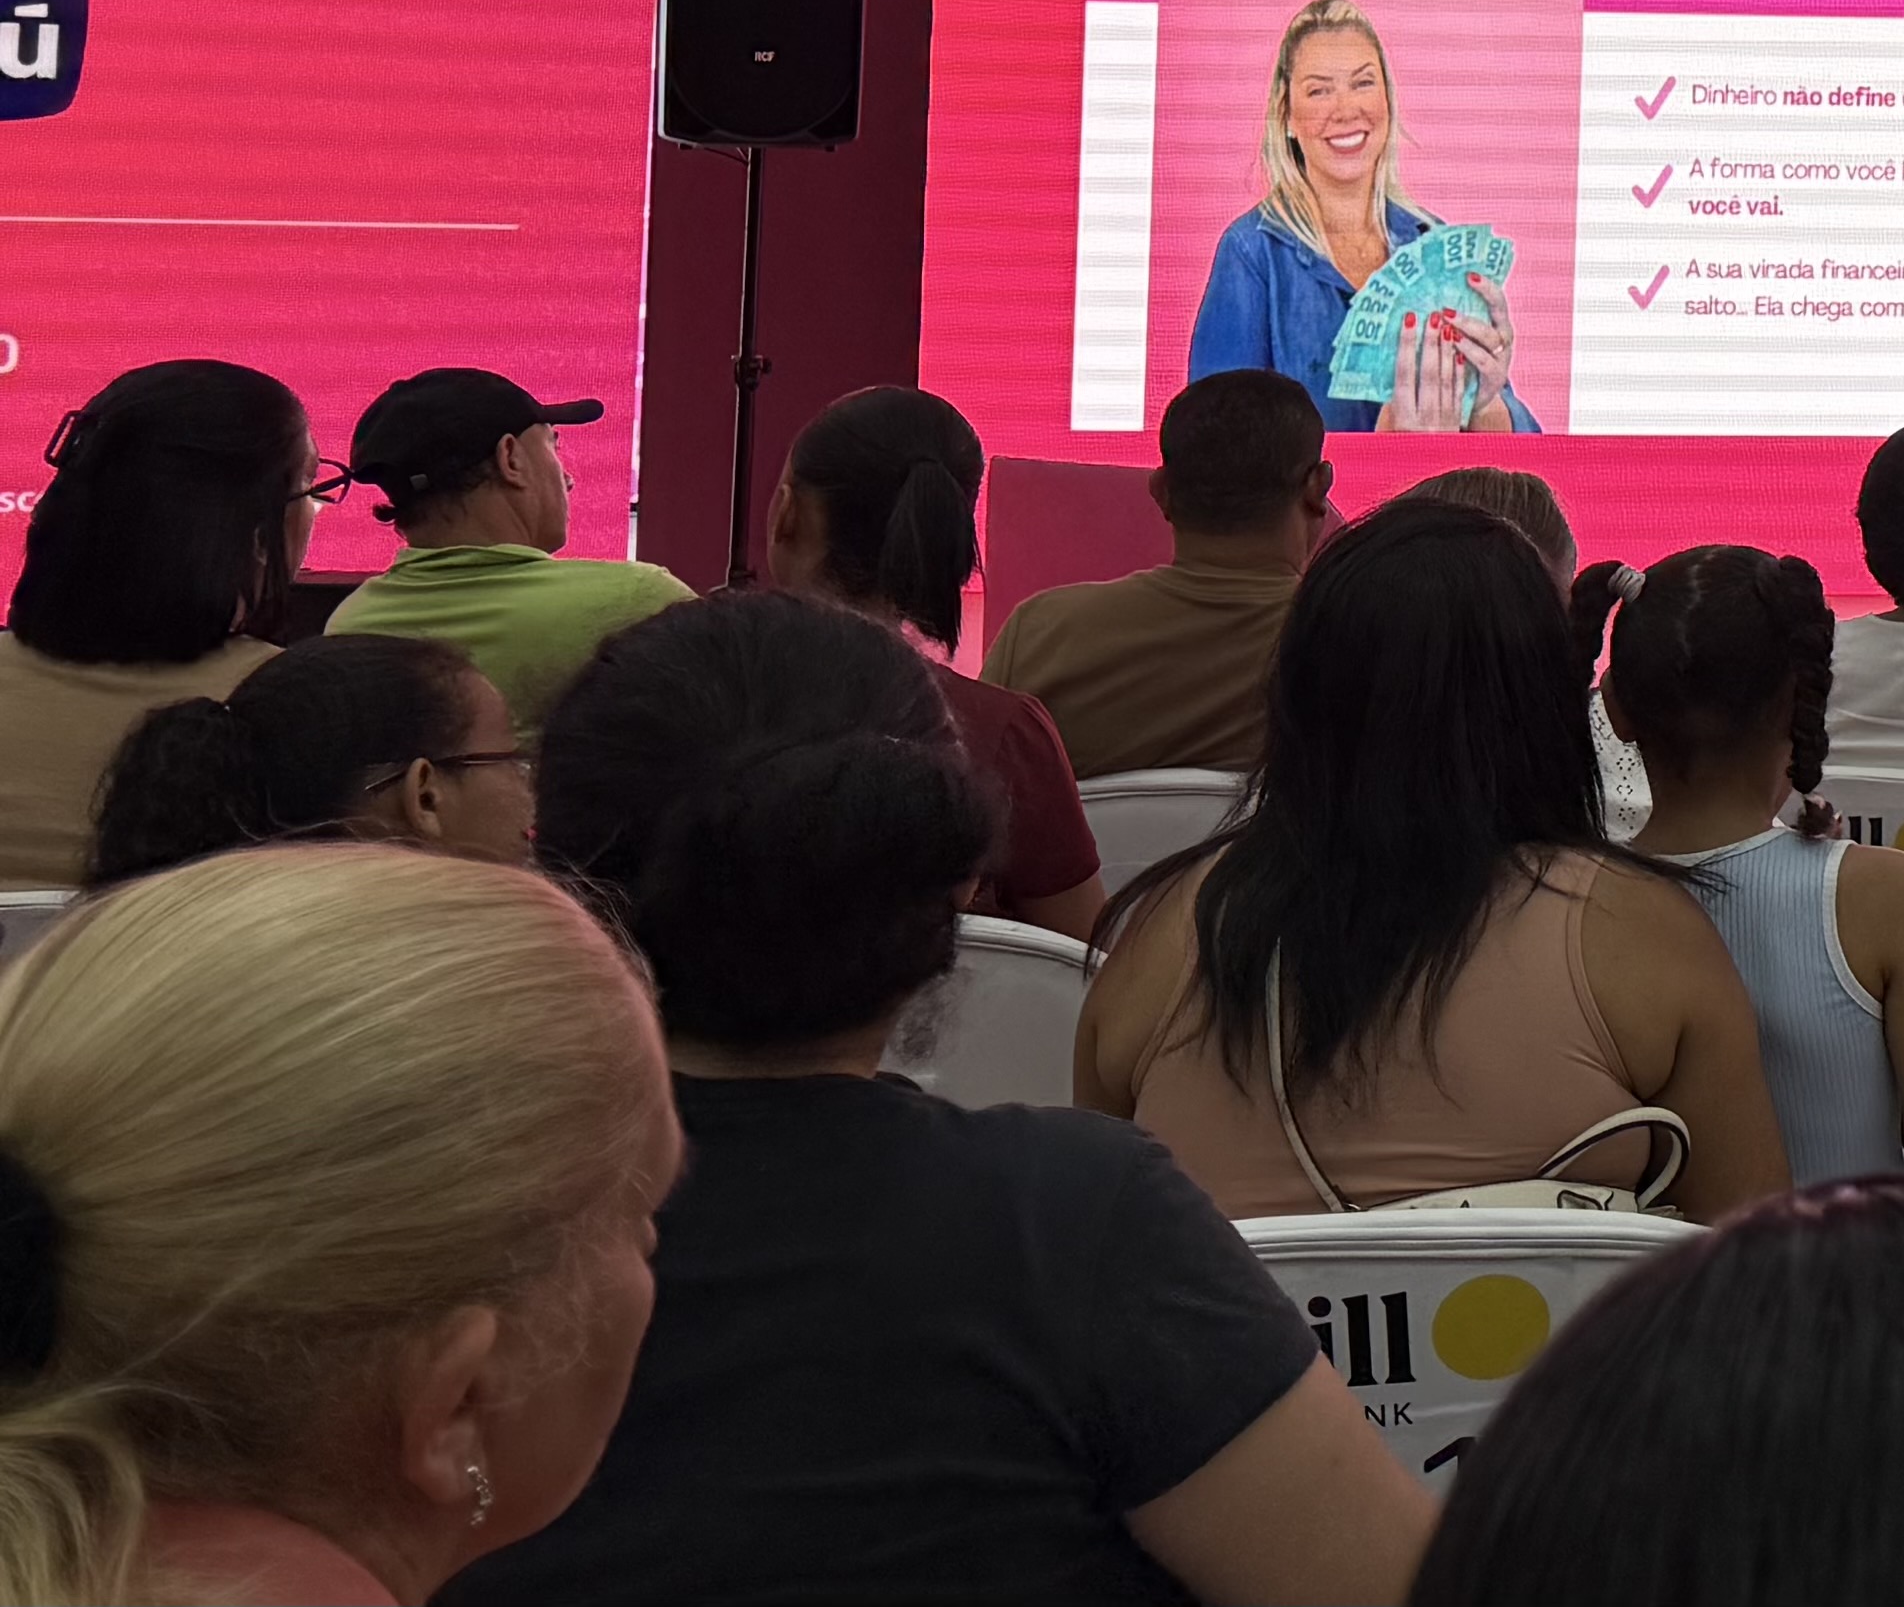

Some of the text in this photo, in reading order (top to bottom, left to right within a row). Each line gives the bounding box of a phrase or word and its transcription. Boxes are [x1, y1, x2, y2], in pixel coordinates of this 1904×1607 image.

[1692, 84, 1777, 105] Dinheiro
[1783, 86, 1822, 106] não
[1829, 86, 1896, 107] define
[1689, 158, 1704, 178] A
[1711, 157, 1775, 179] forma
[1782, 163, 1840, 180] como
[1847, 159, 1896, 180] você
[1689, 195, 1783, 215] você vai.
[1685, 259, 1701, 278] A
[1707, 262, 1742, 278] sua
[1749, 259, 1814, 279] virada
[1754, 296, 1784, 315] Ela
[1791, 296, 1853, 321] chega
[1860, 301, 1904, 316] com
[1307, 1291, 1416, 1387] ill
